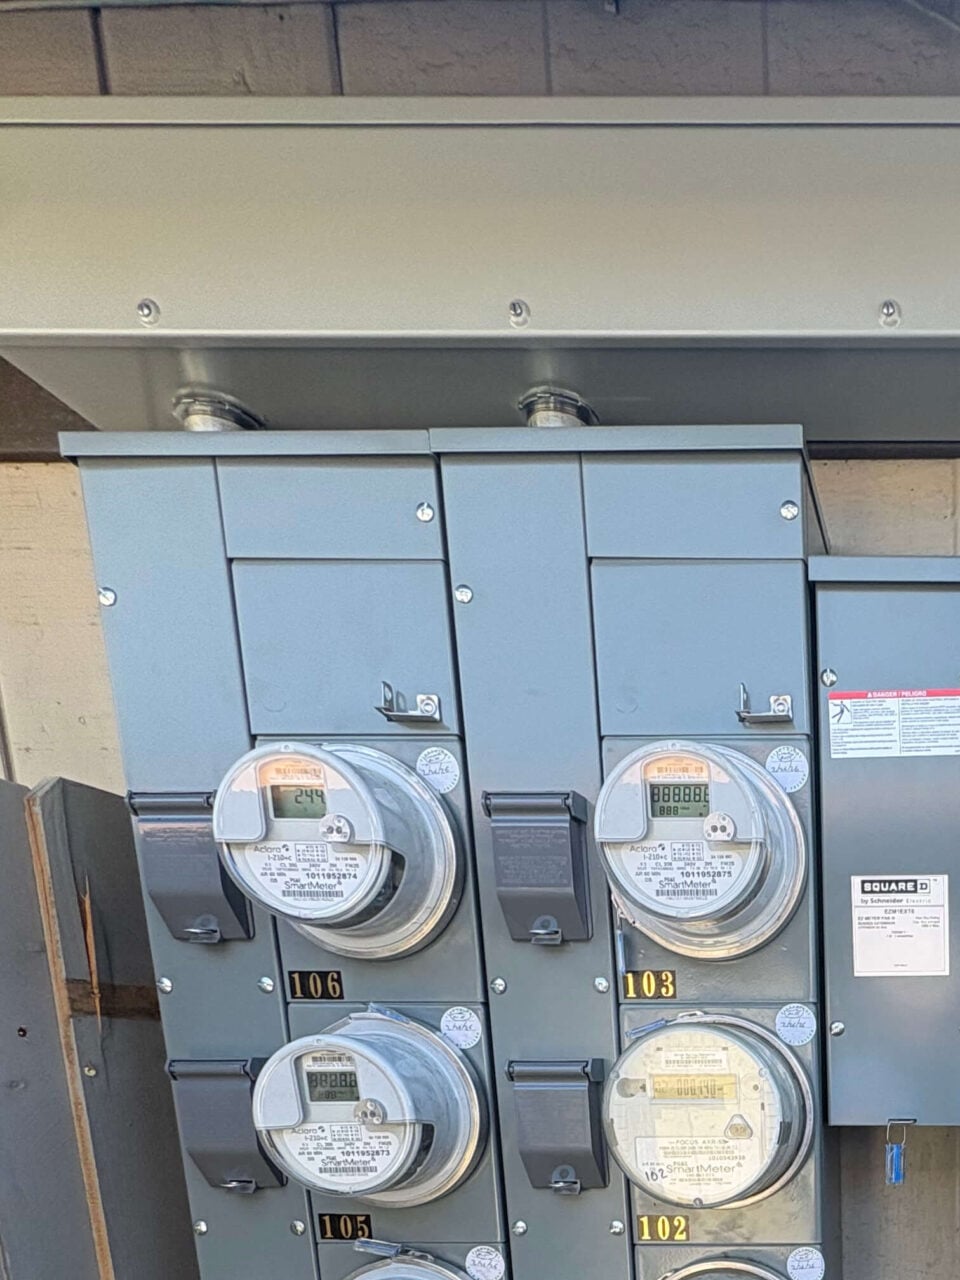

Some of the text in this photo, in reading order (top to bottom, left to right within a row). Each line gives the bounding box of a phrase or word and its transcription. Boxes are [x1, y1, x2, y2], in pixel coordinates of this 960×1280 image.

[284, 882, 337, 890] SmartMeter
[658, 880, 712, 888] SmartMeter
[863, 882, 915, 892] SQUARE
[291, 972, 340, 998] 106
[624, 970, 674, 998] 103
[645, 1168, 668, 1181] 102
[666, 1164, 736, 1174] SmartMeter
[322, 1215, 369, 1238] 105
[640, 1215, 687, 1240] 102
